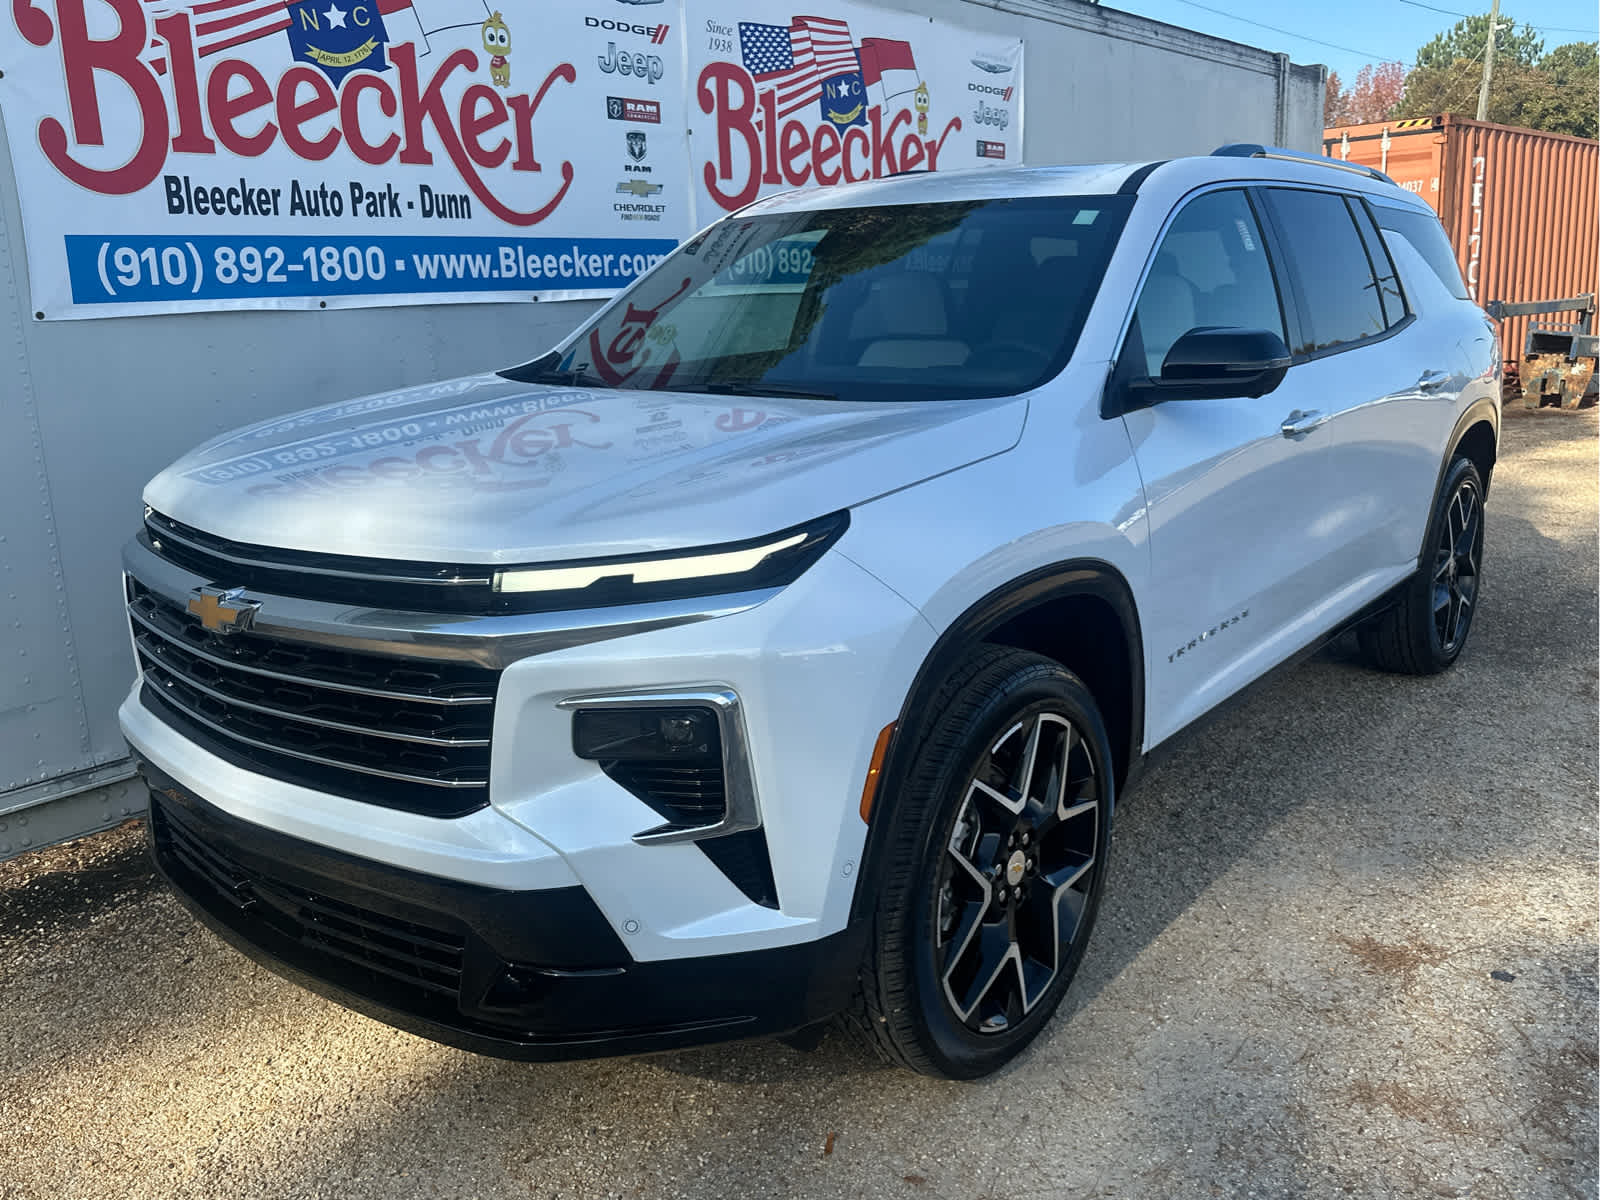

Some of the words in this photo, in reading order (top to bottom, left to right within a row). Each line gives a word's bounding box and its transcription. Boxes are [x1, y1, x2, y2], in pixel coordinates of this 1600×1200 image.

[585, 16, 659, 38] DODGE
[706, 19, 733, 36] Since
[708, 37, 733, 53] 1938
[319, 53, 343, 64] APRIL
[598, 42, 664, 85] Jeep
[968, 82, 1006, 97] DODGE
[11, 0, 577, 226] Bleecker
[626, 103, 657, 112] RAM
[973, 100, 1009, 132] Jeep
[698, 61, 962, 213] Bleecker
[624, 165, 652, 173] RAM
[164, 175, 281, 216] Bleecker
[289, 179, 344, 218] Auto
[349, 182, 402, 218] Park
[419, 184, 472, 220] Dunn
[613, 203, 666, 213] CHEVROLET
[97, 242, 204, 296] (910)
[214, 245, 386, 284] 892-1800
[1168, 608, 1250, 664] TRAVERSE
